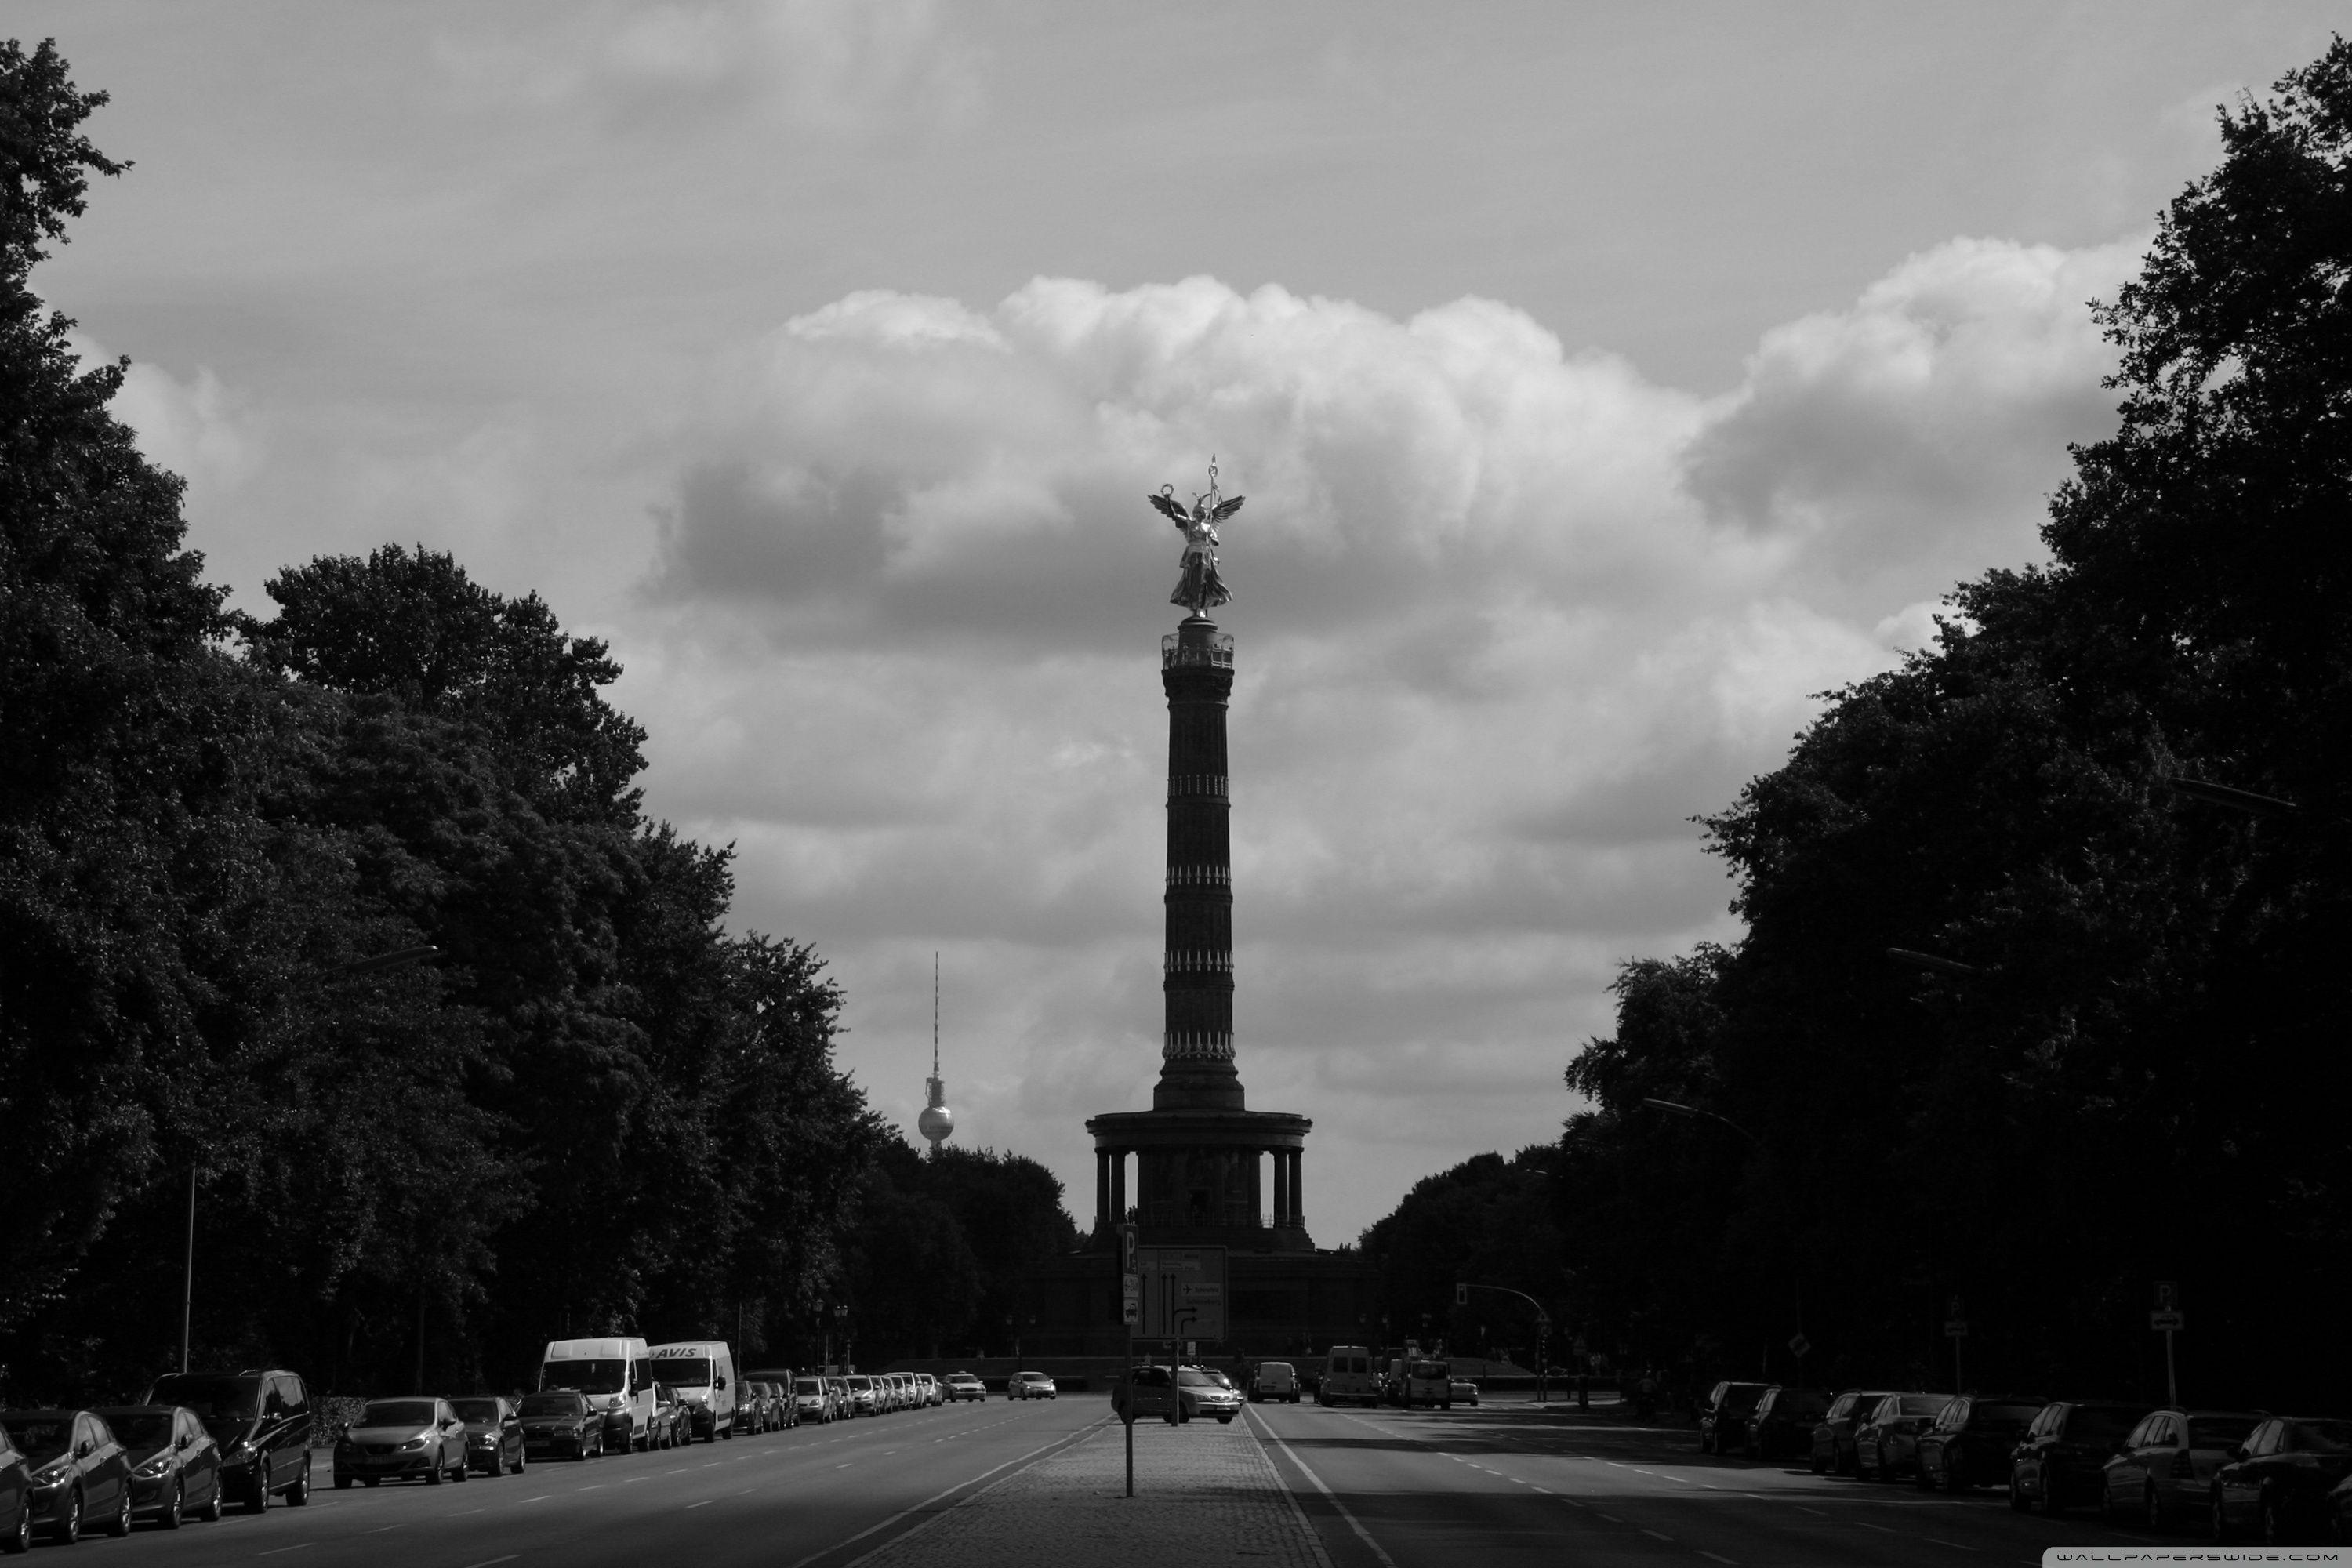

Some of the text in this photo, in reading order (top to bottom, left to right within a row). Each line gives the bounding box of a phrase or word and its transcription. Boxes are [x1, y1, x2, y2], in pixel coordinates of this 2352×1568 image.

[1127, 1231, 1134, 1268] P
[2160, 1284, 2171, 1303] P
[656, 1348, 696, 1359] AVIS
